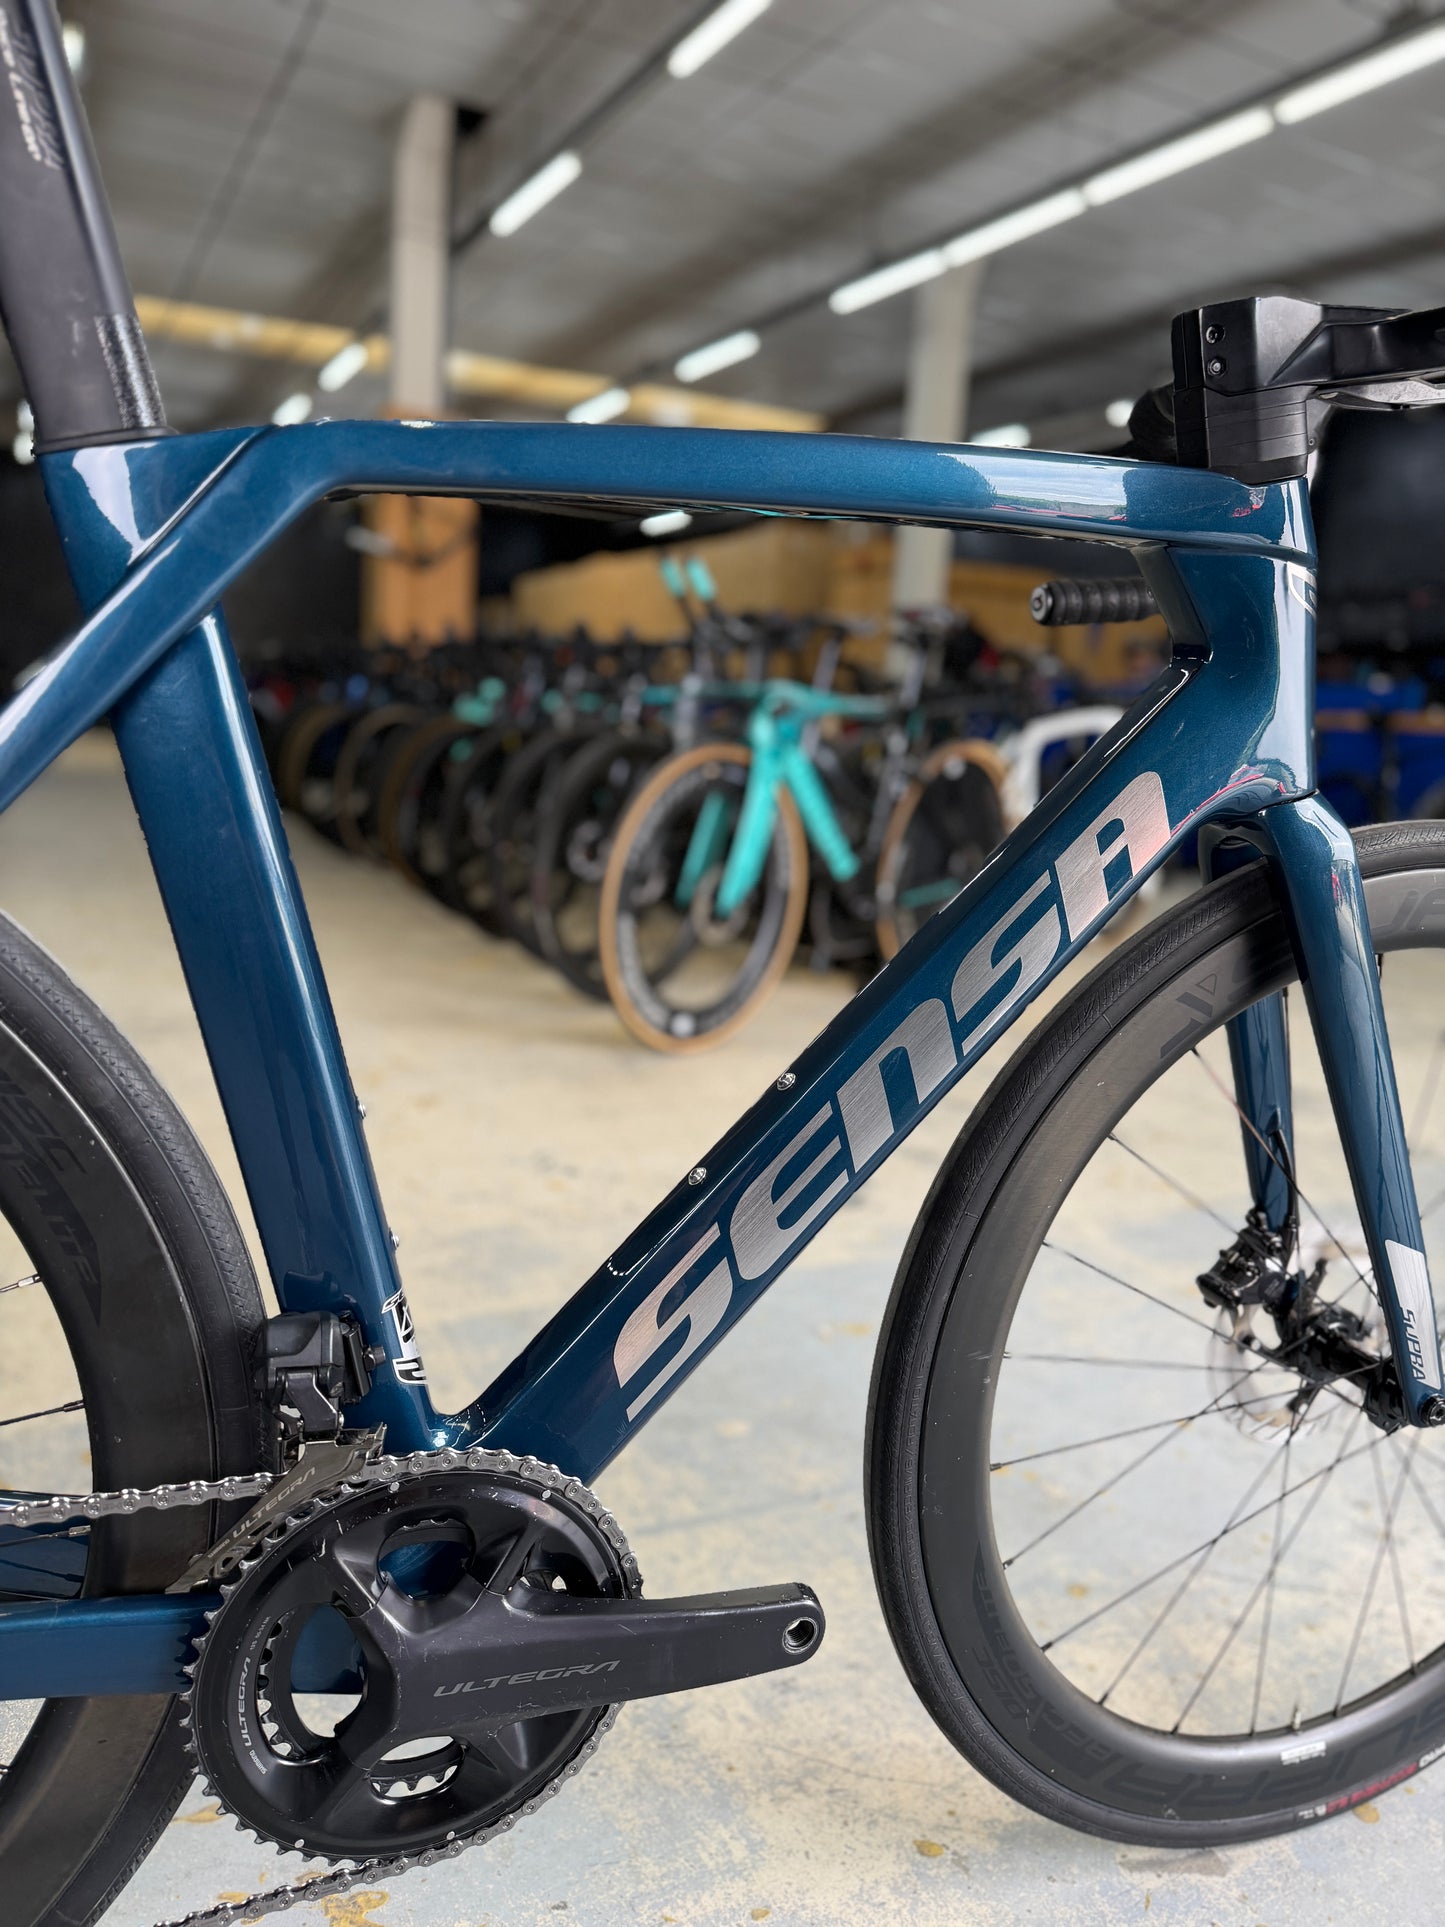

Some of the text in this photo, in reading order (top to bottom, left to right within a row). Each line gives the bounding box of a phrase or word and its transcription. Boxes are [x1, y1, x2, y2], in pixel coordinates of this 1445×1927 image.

[1401, 1306, 1427, 1381] SUPRA
[232, 1466, 316, 1539] ULTEGRA
[238, 1656, 252, 1747] ULTEGRA
[433, 1659, 621, 1698] ULTEGRA
